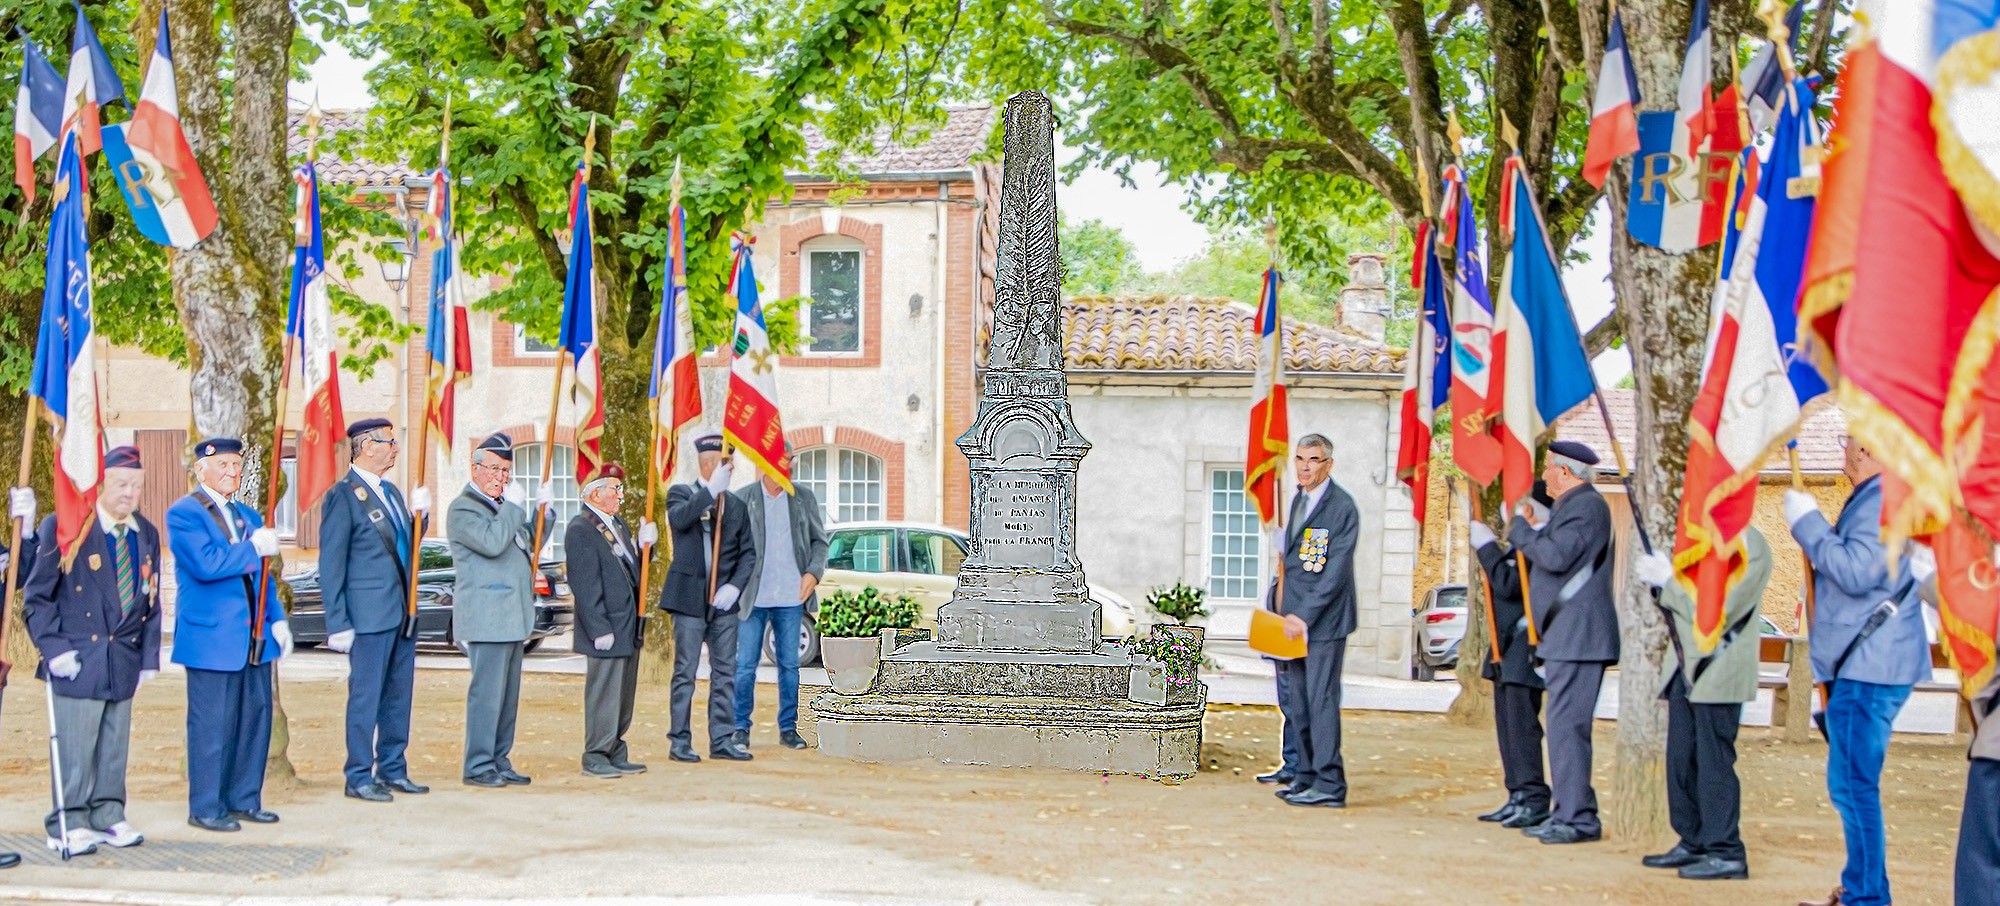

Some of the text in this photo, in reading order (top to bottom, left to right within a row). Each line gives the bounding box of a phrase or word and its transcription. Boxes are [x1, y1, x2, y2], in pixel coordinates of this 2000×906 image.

[118, 160, 187, 208] RF
[1638, 151, 1739, 207] RF
[1004, 522, 1034, 531] MORTS
[1019, 537, 1055, 546] FRANCE
